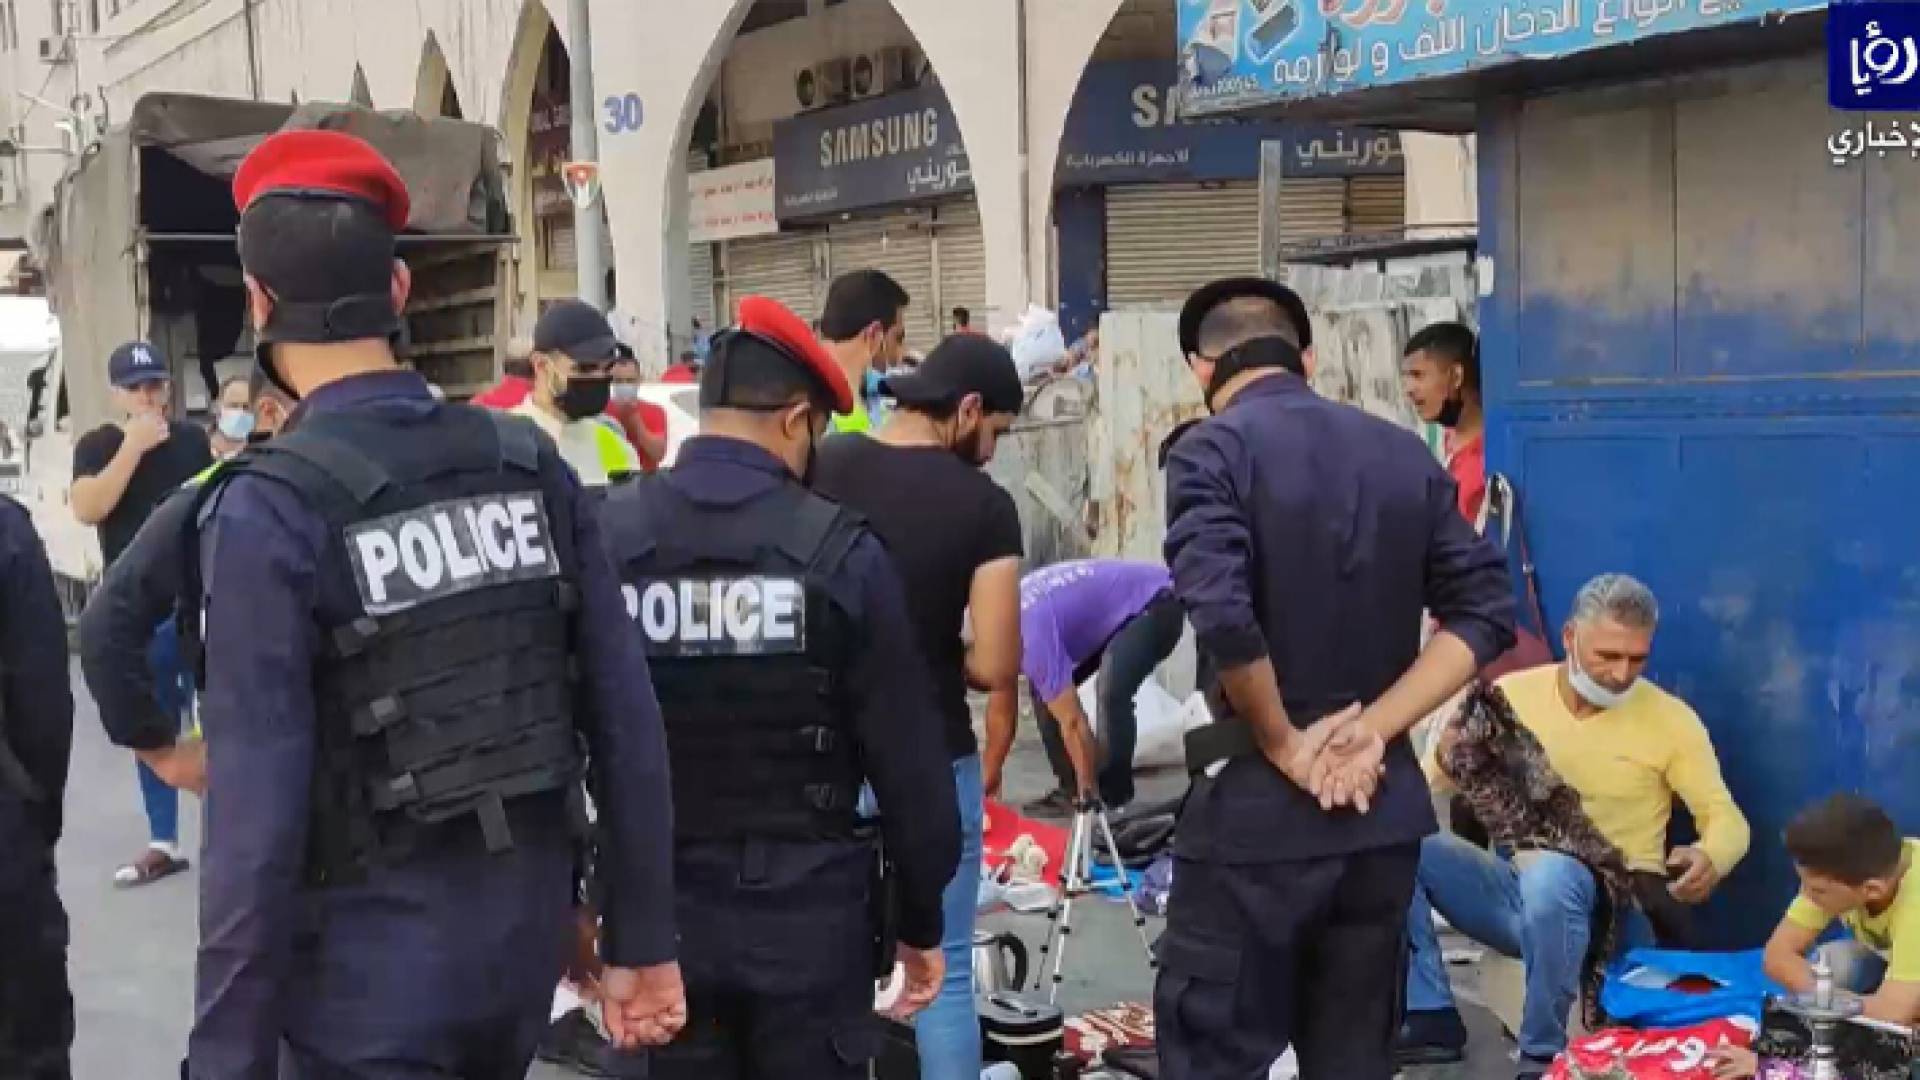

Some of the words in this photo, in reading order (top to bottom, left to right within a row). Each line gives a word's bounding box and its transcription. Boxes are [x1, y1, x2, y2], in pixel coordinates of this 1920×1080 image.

[1371, 40, 1389, 77] و
[604, 92, 644, 135] 30
[820, 107, 938, 168] SAMSUNG
[355, 498, 547, 603] POLICE
